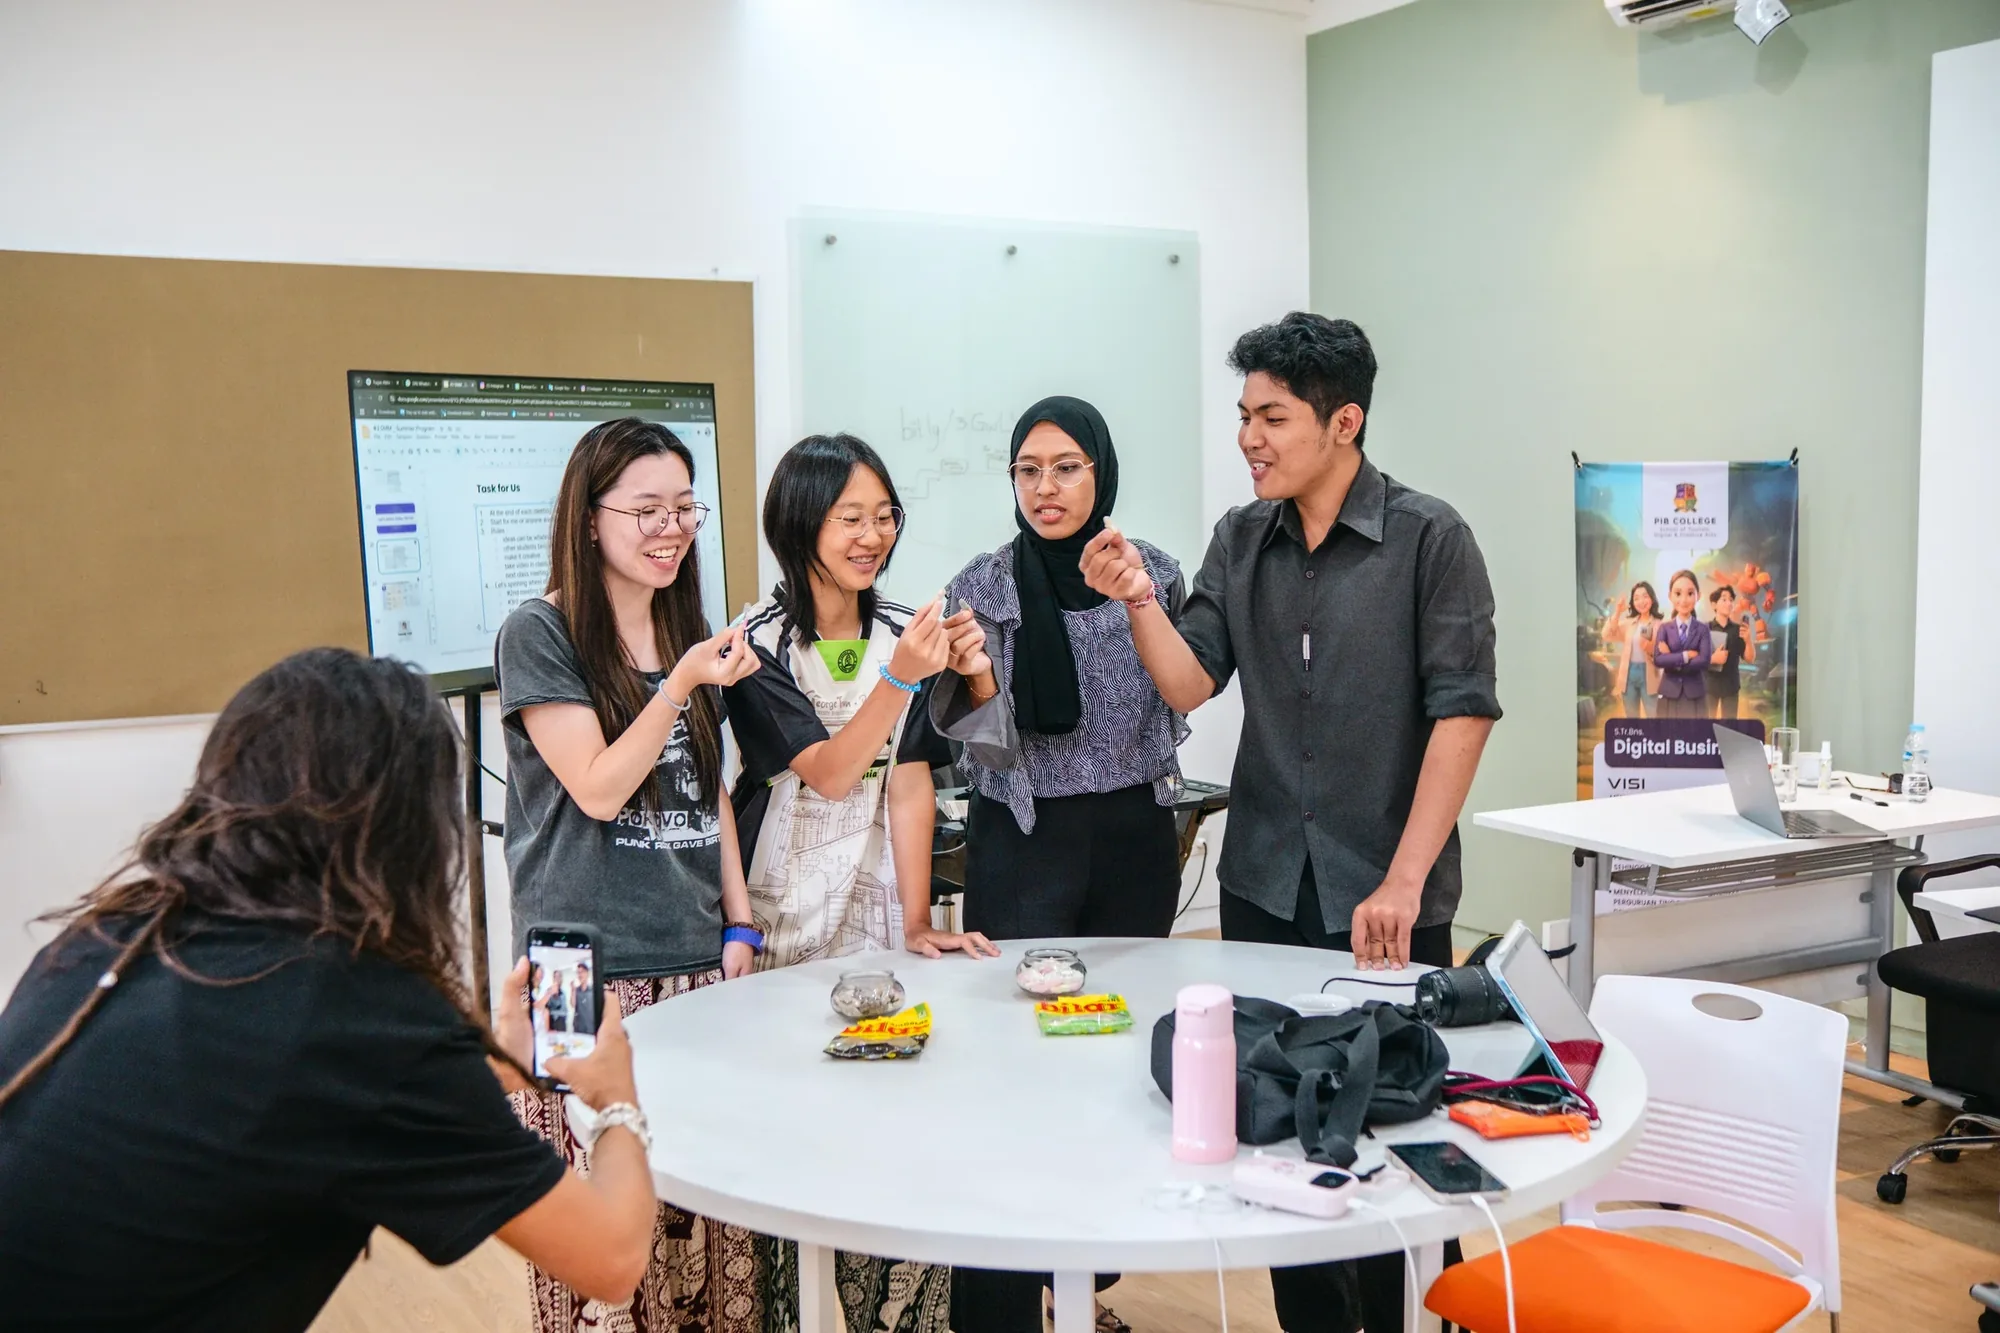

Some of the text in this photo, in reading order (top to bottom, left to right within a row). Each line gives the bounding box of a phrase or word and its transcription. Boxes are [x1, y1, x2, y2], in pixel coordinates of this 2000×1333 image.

[477, 483, 520, 493] Task for Us
[1654, 517, 1717, 525] PIB COLLEGE
[1614, 738, 1721, 759] Digital Busin
[1608, 778, 1645, 790] VISI
[616, 837, 651, 849] PUNK
[673, 840, 703, 850] GAVE
